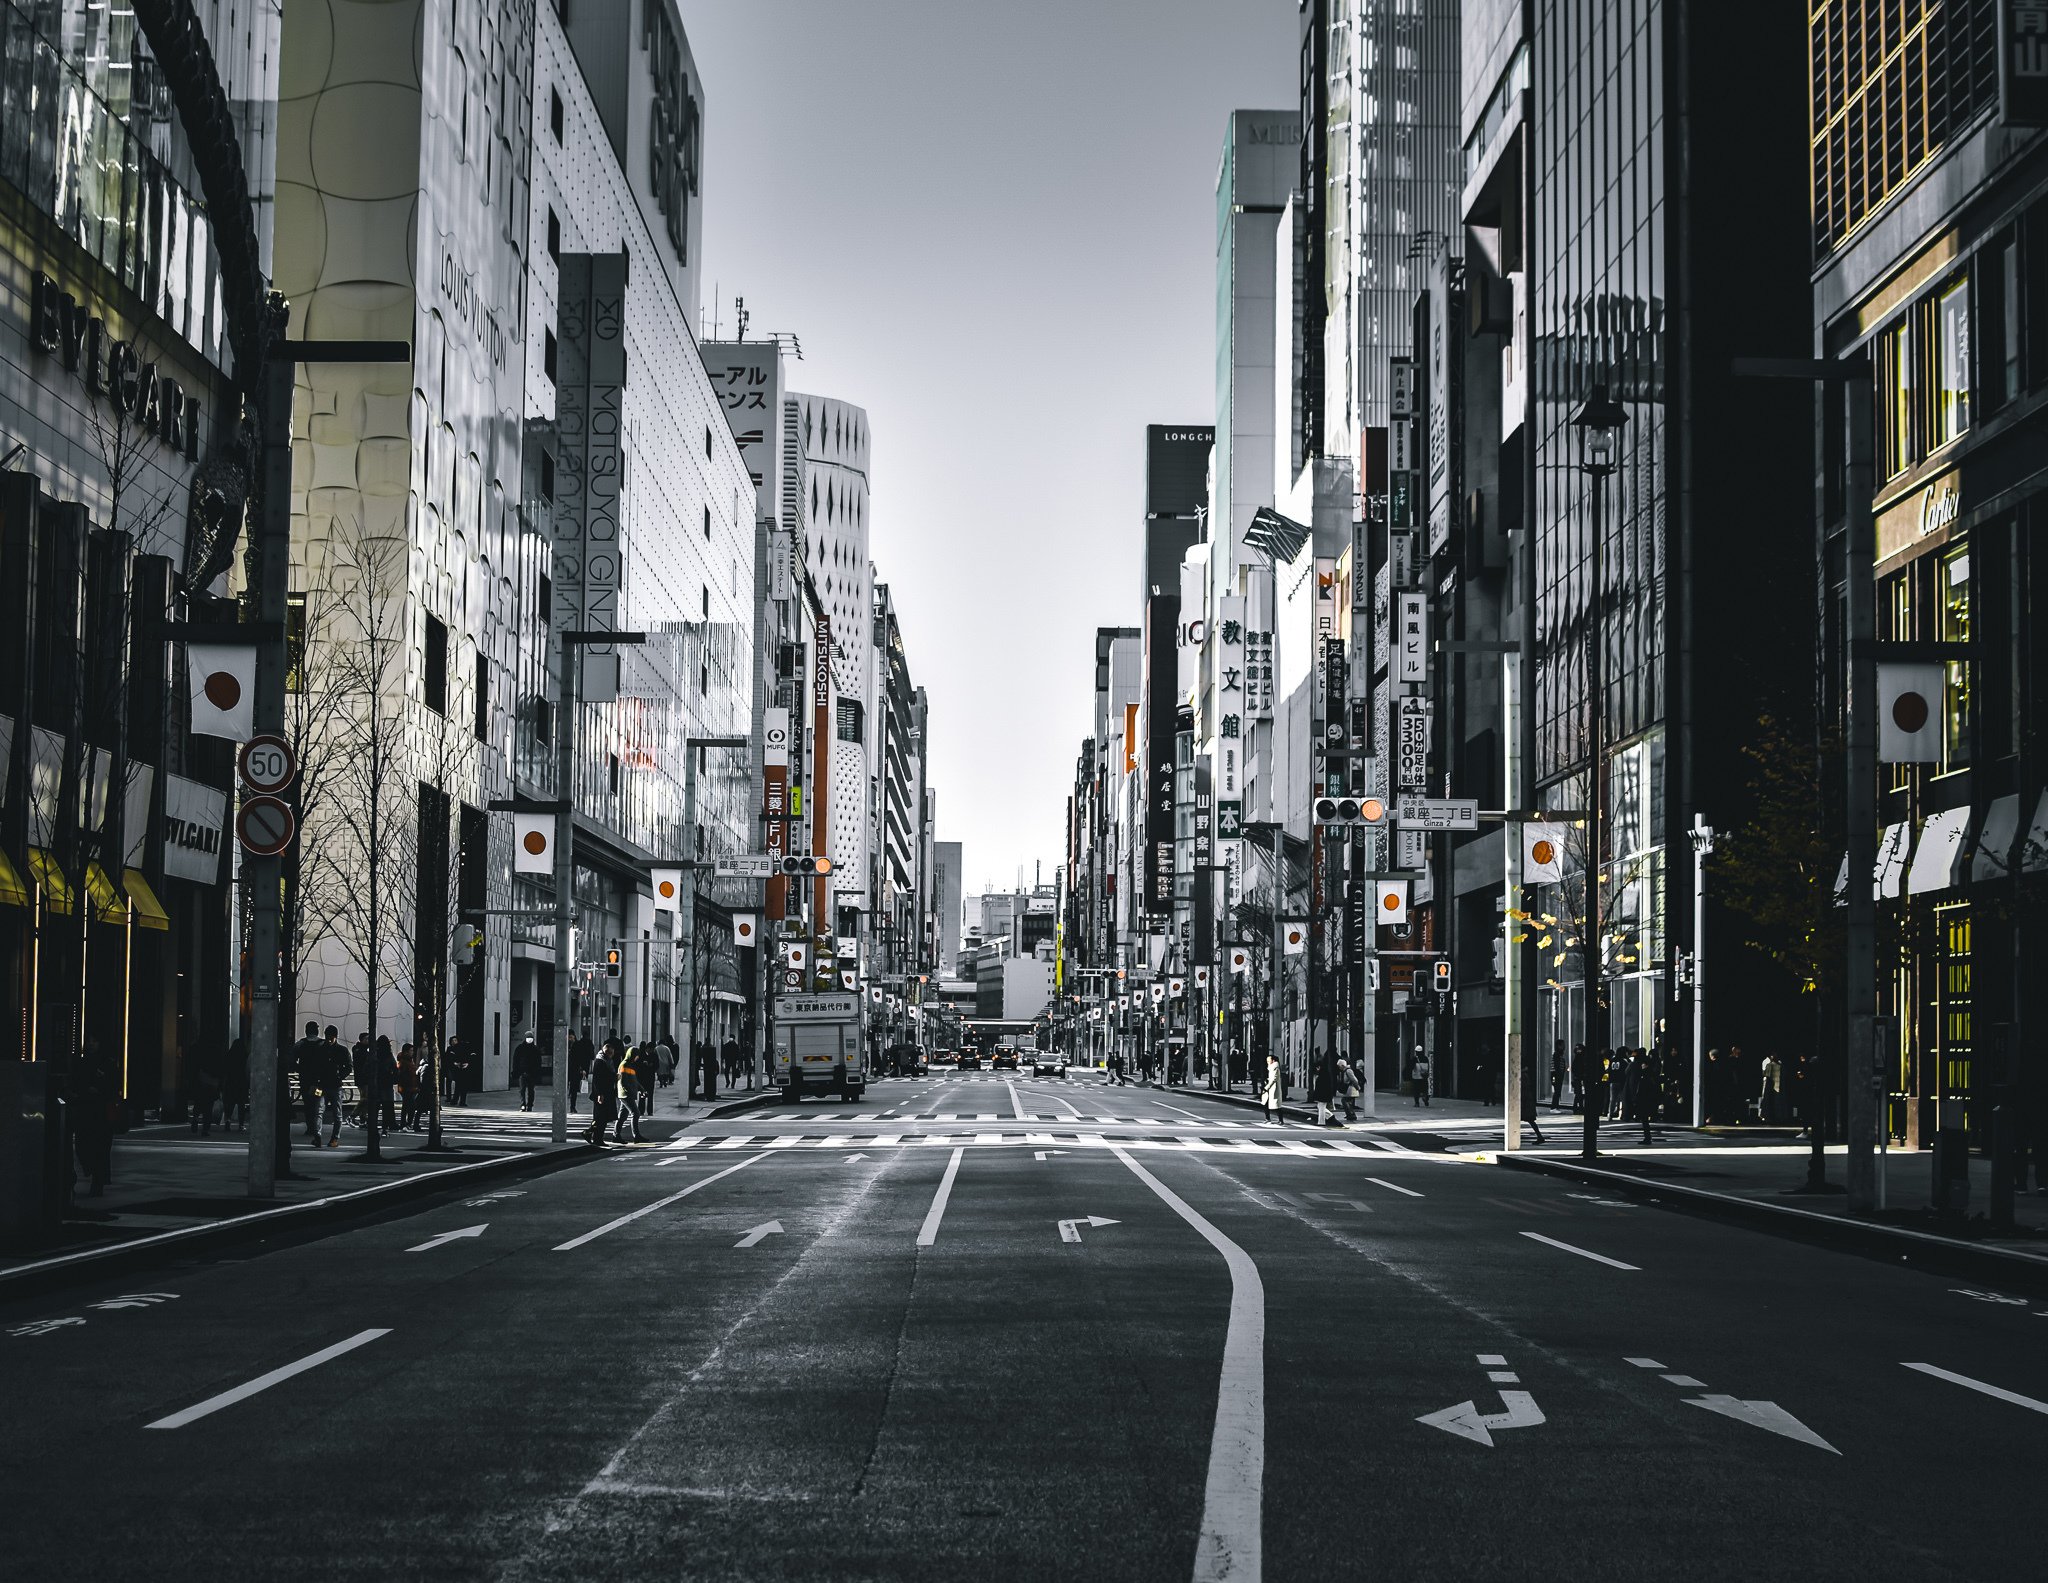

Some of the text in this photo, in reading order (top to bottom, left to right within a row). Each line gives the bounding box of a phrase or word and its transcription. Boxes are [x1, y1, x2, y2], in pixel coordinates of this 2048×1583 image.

[441, 244, 507, 376] LOUIS VUITTON
[30, 270, 201, 463] BVLGARI
[1165, 433, 1212, 441] LONGCH
[1919, 482, 1960, 537] Cartier
[816, 620, 828, 708] MITSUKOSHI
[1406, 602, 1420, 673] 南風ビル
[1220, 620, 1242, 738] 教文館
[1247, 631, 1260, 711] 教文館ビル
[252, 751, 283, 778] 50
[1220, 806, 1239, 833] 本
[1403, 807, 1472, 820] 銀座二丁目
[719, 861, 769, 870] 銀座二丁目
